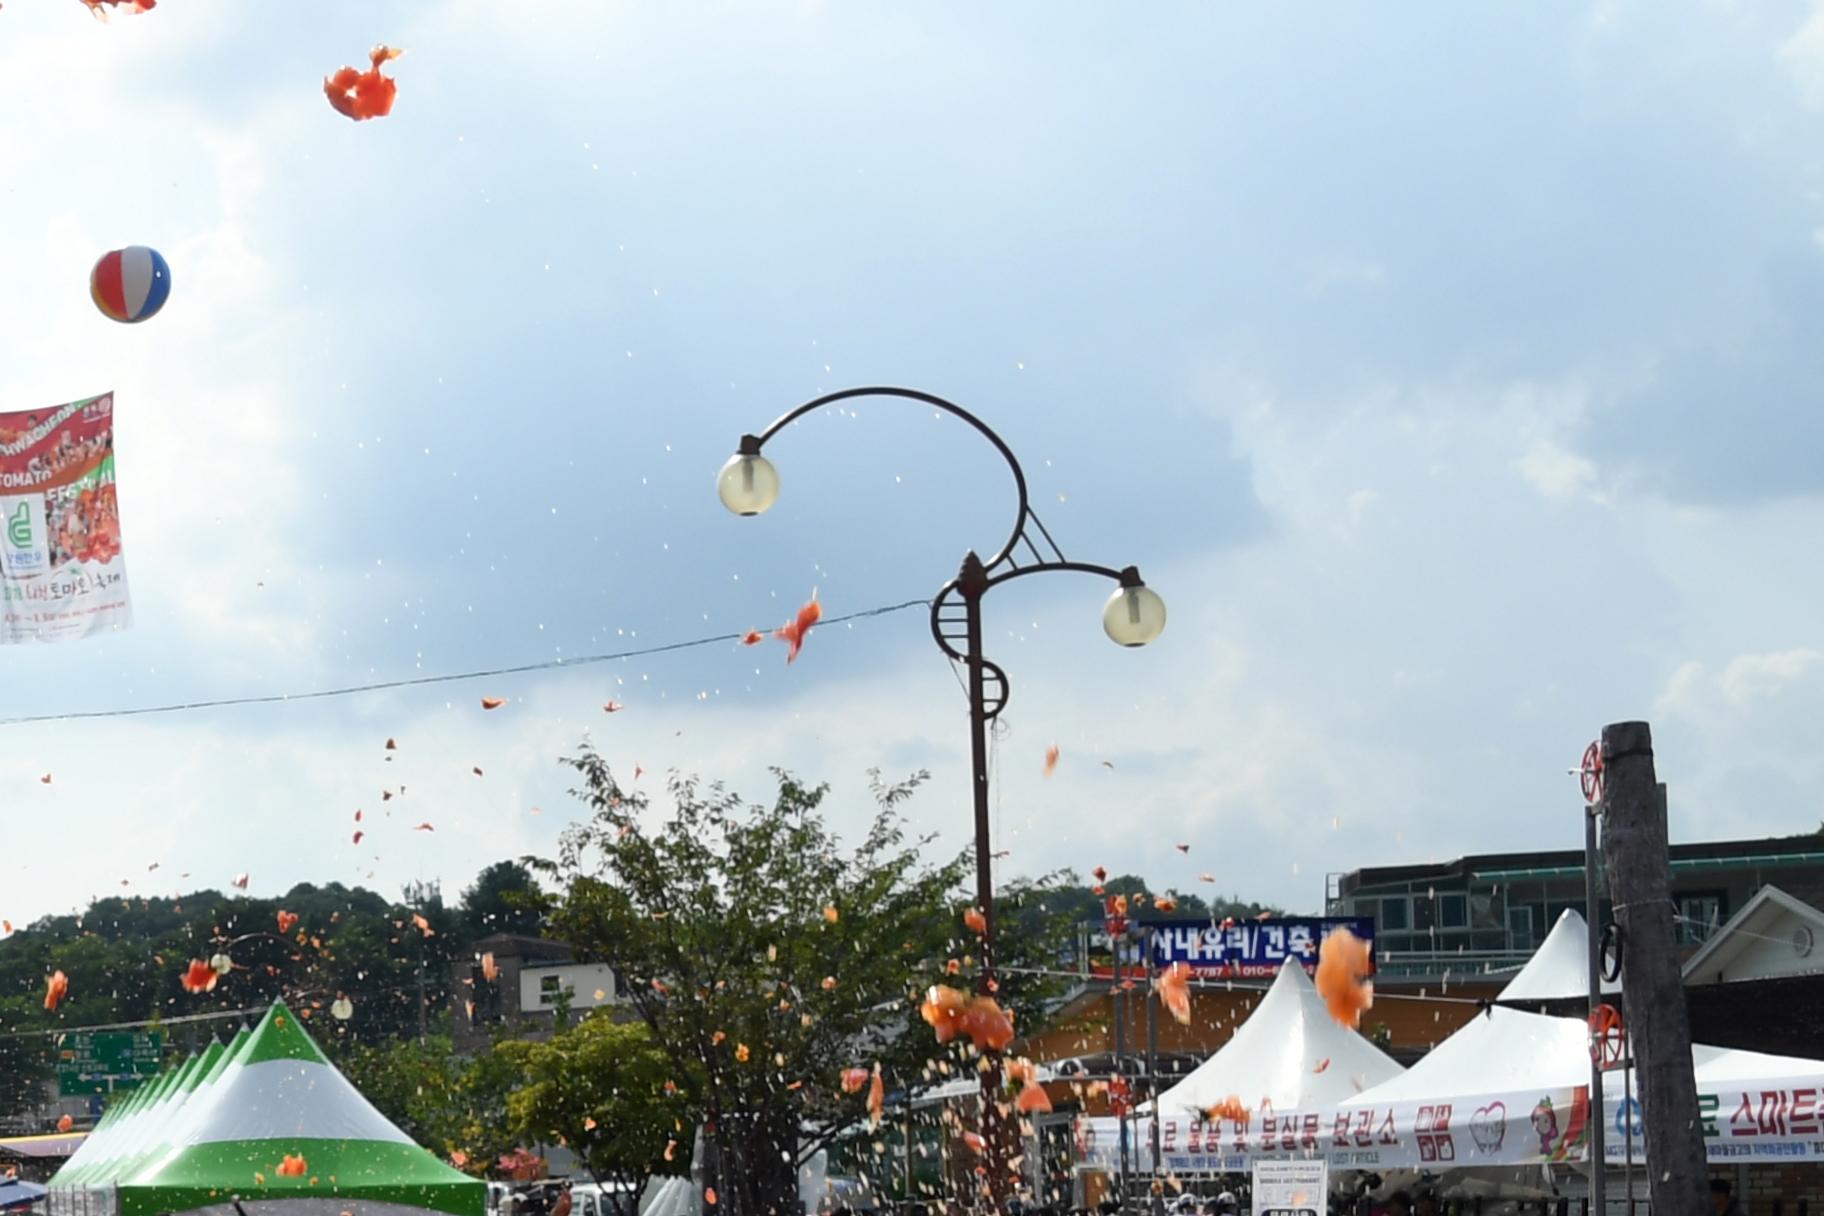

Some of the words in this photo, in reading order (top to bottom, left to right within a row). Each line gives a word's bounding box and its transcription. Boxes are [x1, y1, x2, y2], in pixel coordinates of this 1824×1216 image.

[1, 402, 77, 457] HWACHEON
[1332, 1108, 1399, 1148] 보관소
[1730, 1087, 1824, 1137] 스마트
